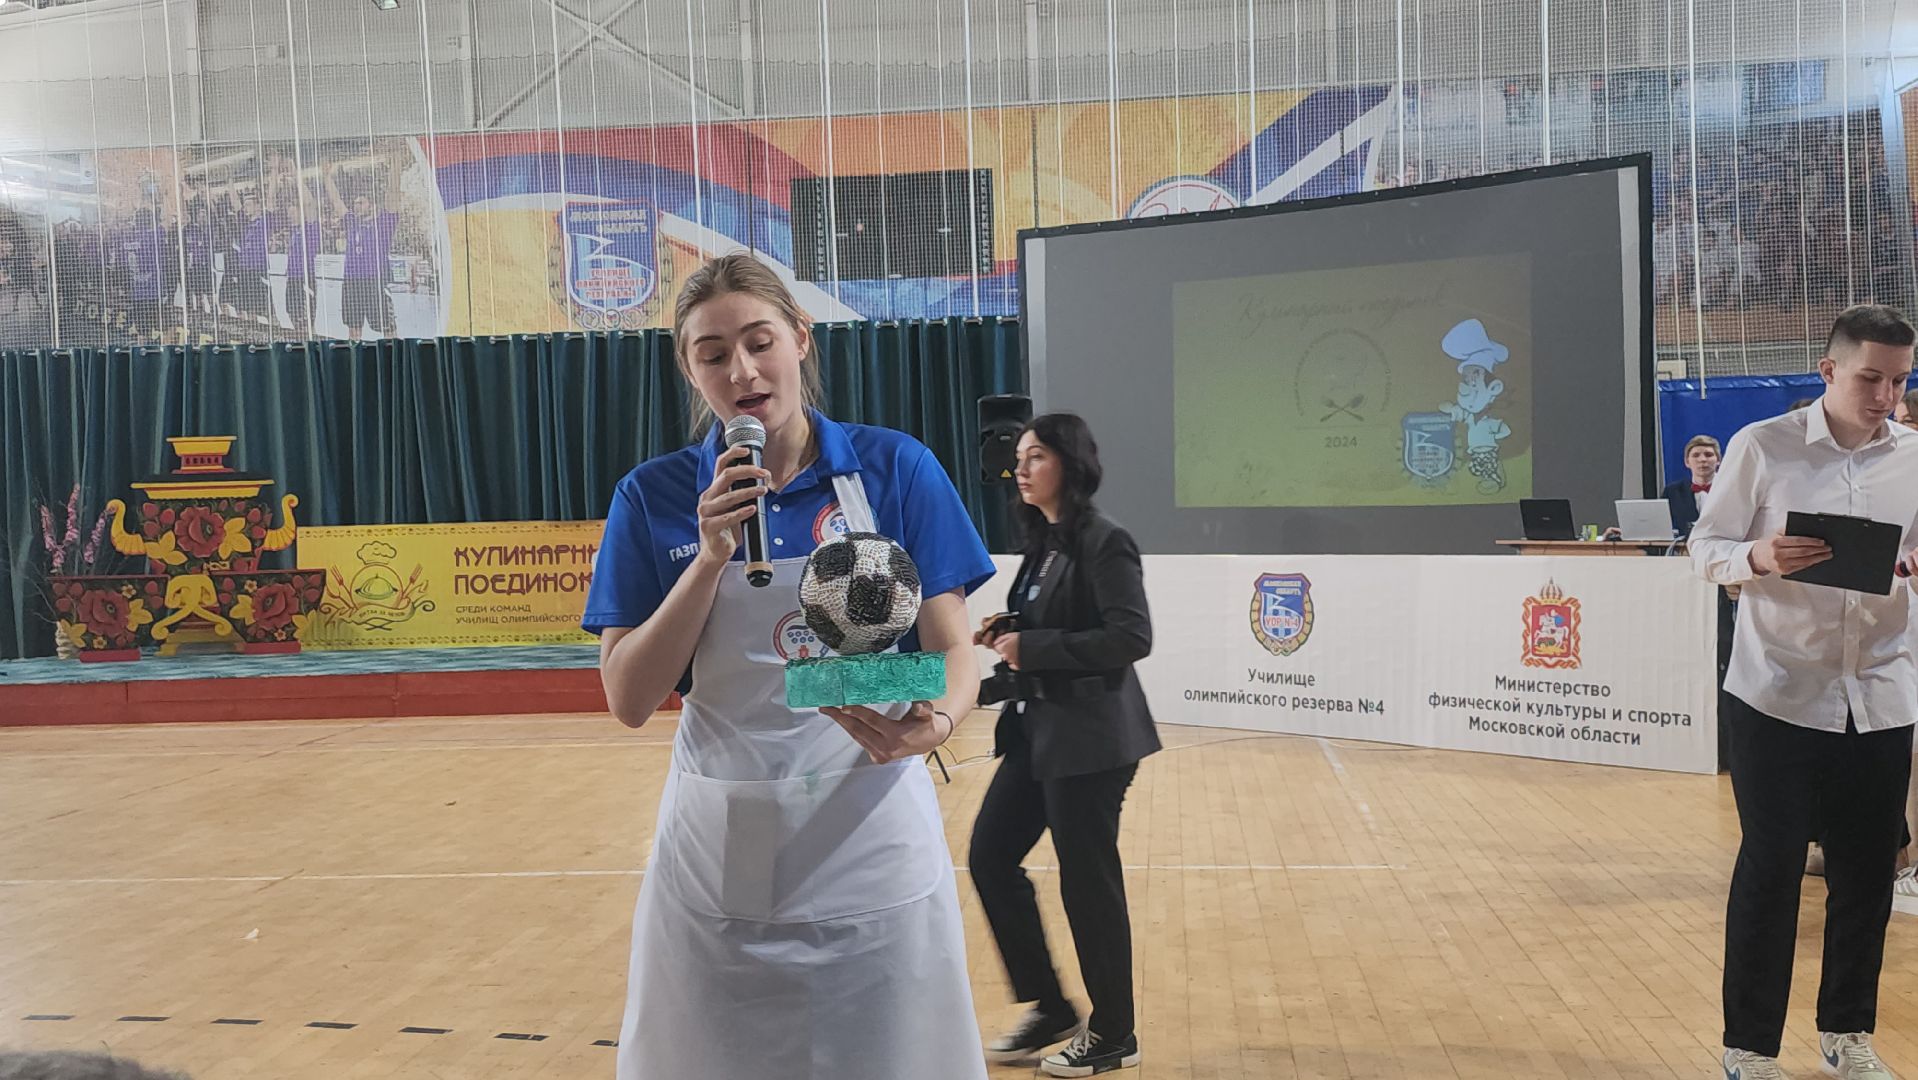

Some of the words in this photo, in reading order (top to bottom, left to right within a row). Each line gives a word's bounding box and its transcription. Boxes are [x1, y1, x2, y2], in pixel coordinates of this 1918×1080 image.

[1324, 435, 1358, 449] 2024
[669, 542, 699, 562] ГАЗП
[454, 571, 593, 595] ПОЕДИНОК
[456, 605, 487, 613] СРЕДИ
[490, 604, 531, 613] КОМАНД
[456, 615, 499, 624] УЧИЛИЩ
[501, 613, 581, 624] ОЛИМПИЙСКОГО
[1247, 668, 1315, 687] Училище
[1495, 675, 1611, 697] Министерство
[1184, 689, 1287, 707] олимпийского
[1292, 695, 1353, 714] резерва
[1358, 698, 1384, 715] №4
[1428, 691, 1521, 713] физической
[1526, 702, 1606, 721] культуры
[1612, 708, 1622, 721] и
[1628, 708, 1692, 727] спорта
[1468, 716, 1565, 739] Московской
[1570, 726, 1641, 745] области
